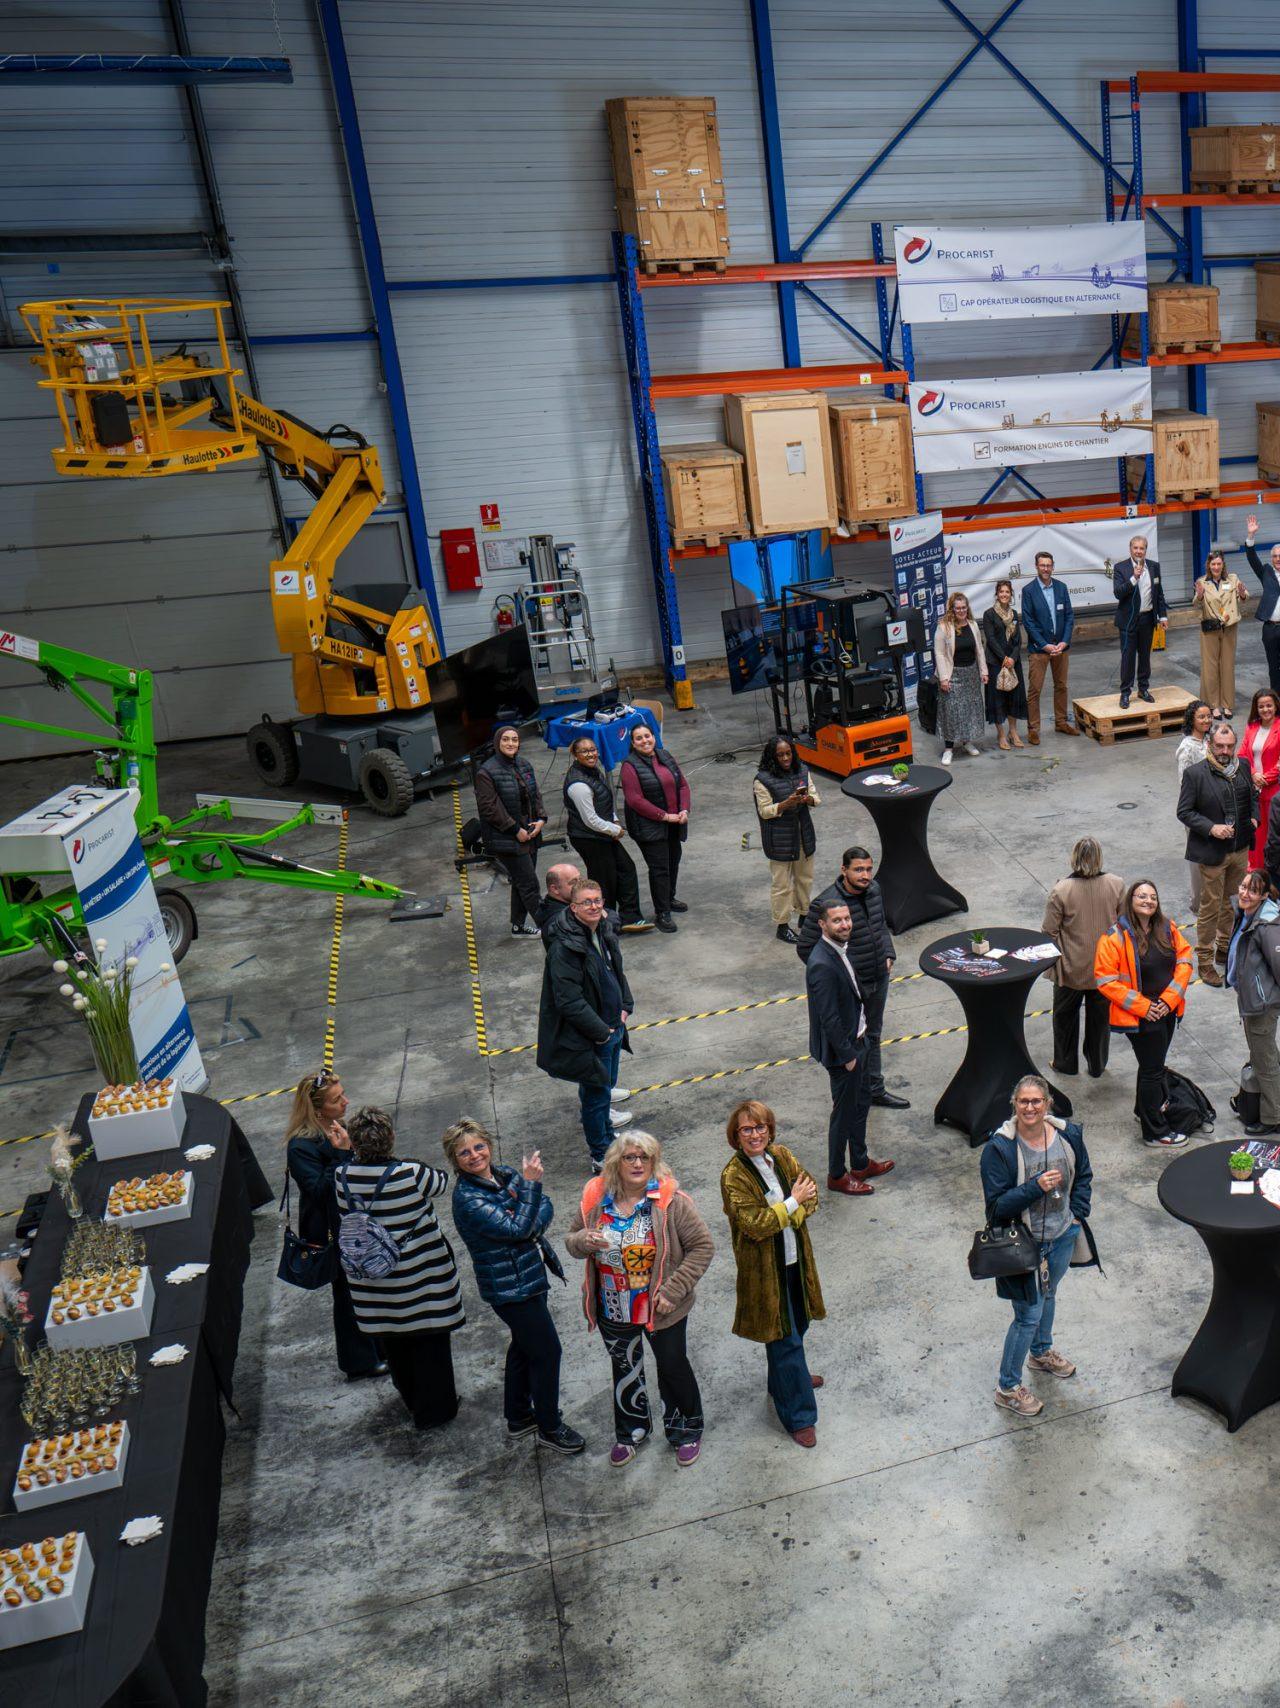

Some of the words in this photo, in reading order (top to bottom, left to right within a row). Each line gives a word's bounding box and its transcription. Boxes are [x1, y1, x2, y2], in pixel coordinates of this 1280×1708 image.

[937, 249, 994, 260] PROCARIST
[960, 298, 975, 307] CAP
[976, 295, 1020, 306] OPÉRATEUR
[1020, 294, 1064, 305] LOGISTIQUE
[1065, 295, 1075, 303] EN
[1075, 292, 1121, 302] ALTERNANCE
[950, 400, 1006, 411] PROCARIST
[240, 400, 276, 433] Haulotte
[993, 444, 1037, 453] FORMATION
[1037, 441, 1063, 451] ENGINS
[1074, 437, 1109, 447] CHANTIER
[182, 448, 218, 465] Haulotte
[1127, 507, 1134, 516] 2
[917, 546, 942, 558] ACTEUR
[958, 551, 1012, 564] PROCARIST
[675, 651, 683, 660] 0
[88, 828, 115, 853] PROCARIST
[142, 1053, 160, 1072] rmations
